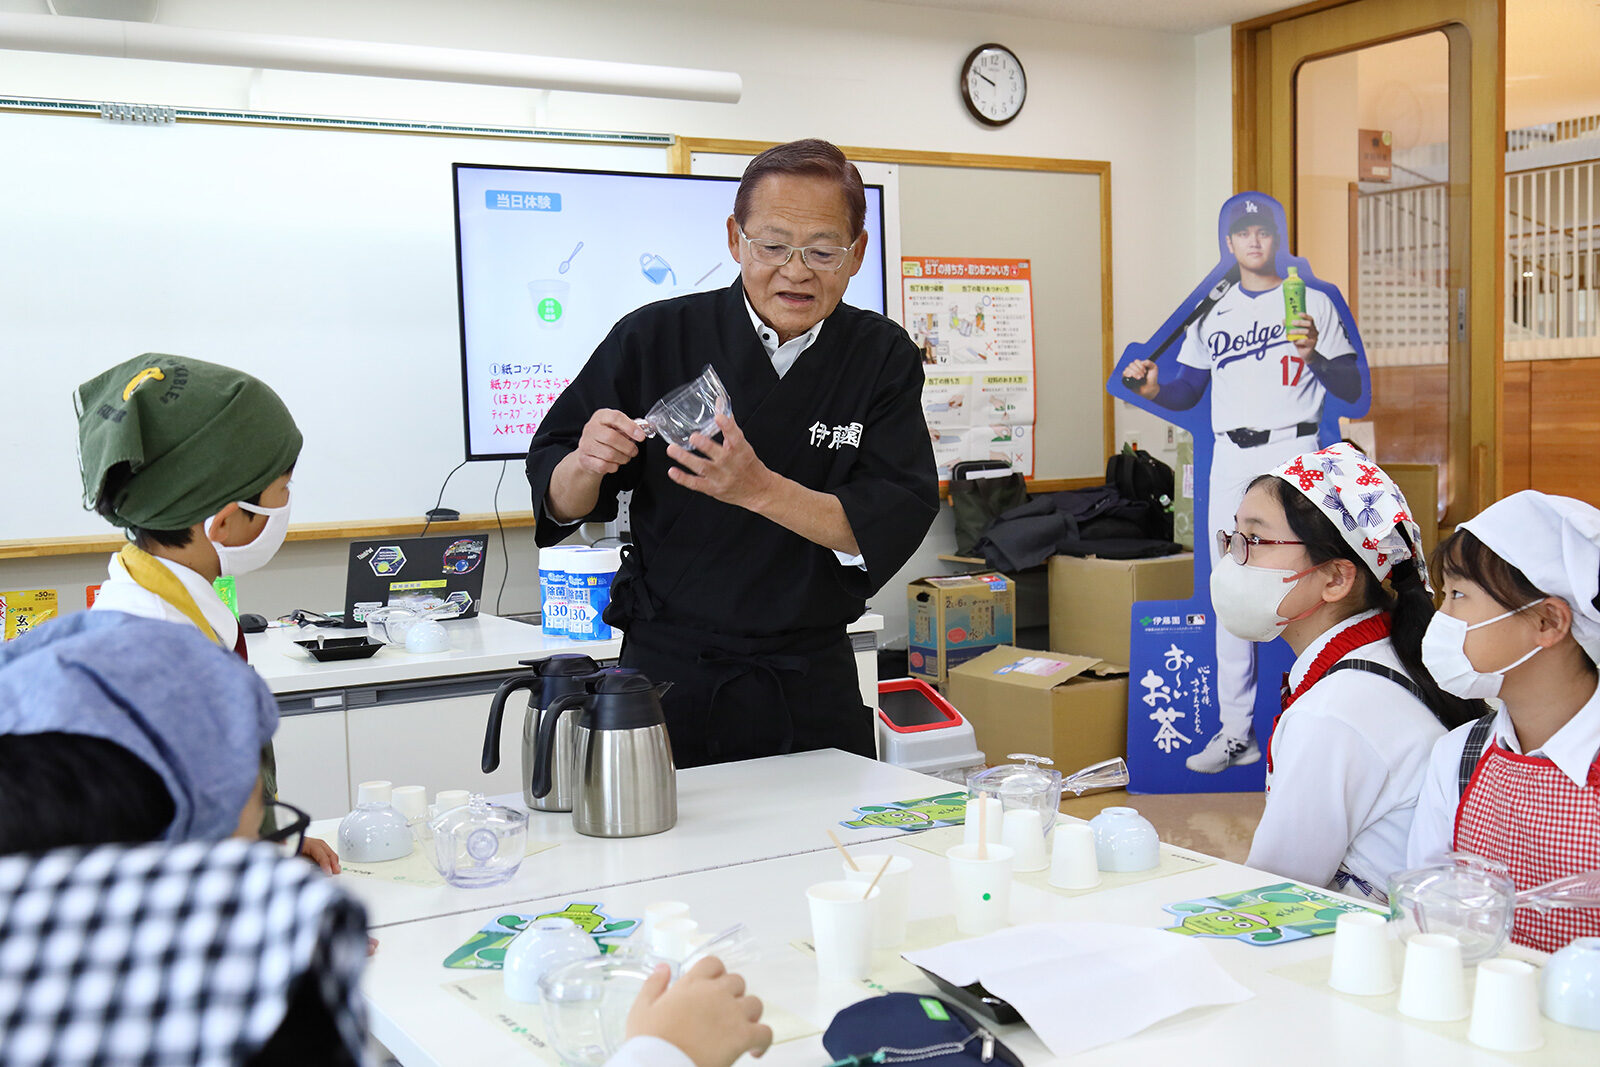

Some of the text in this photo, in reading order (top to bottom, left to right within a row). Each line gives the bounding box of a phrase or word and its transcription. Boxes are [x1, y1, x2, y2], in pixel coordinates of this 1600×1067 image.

[990, 55, 999, 65] 12
[497, 193, 552, 210] 当日体験
[1208, 321, 1286, 361] Dodge
[1280, 355, 1305, 387] 17
[493, 393, 560, 405] （ほうじ、玄米
[809, 420, 864, 450] 伊藤園
[548, 605, 568, 617] 130
[1152, 616, 1181, 626] 伊藤園
[1140, 669, 1193, 754] お茶
